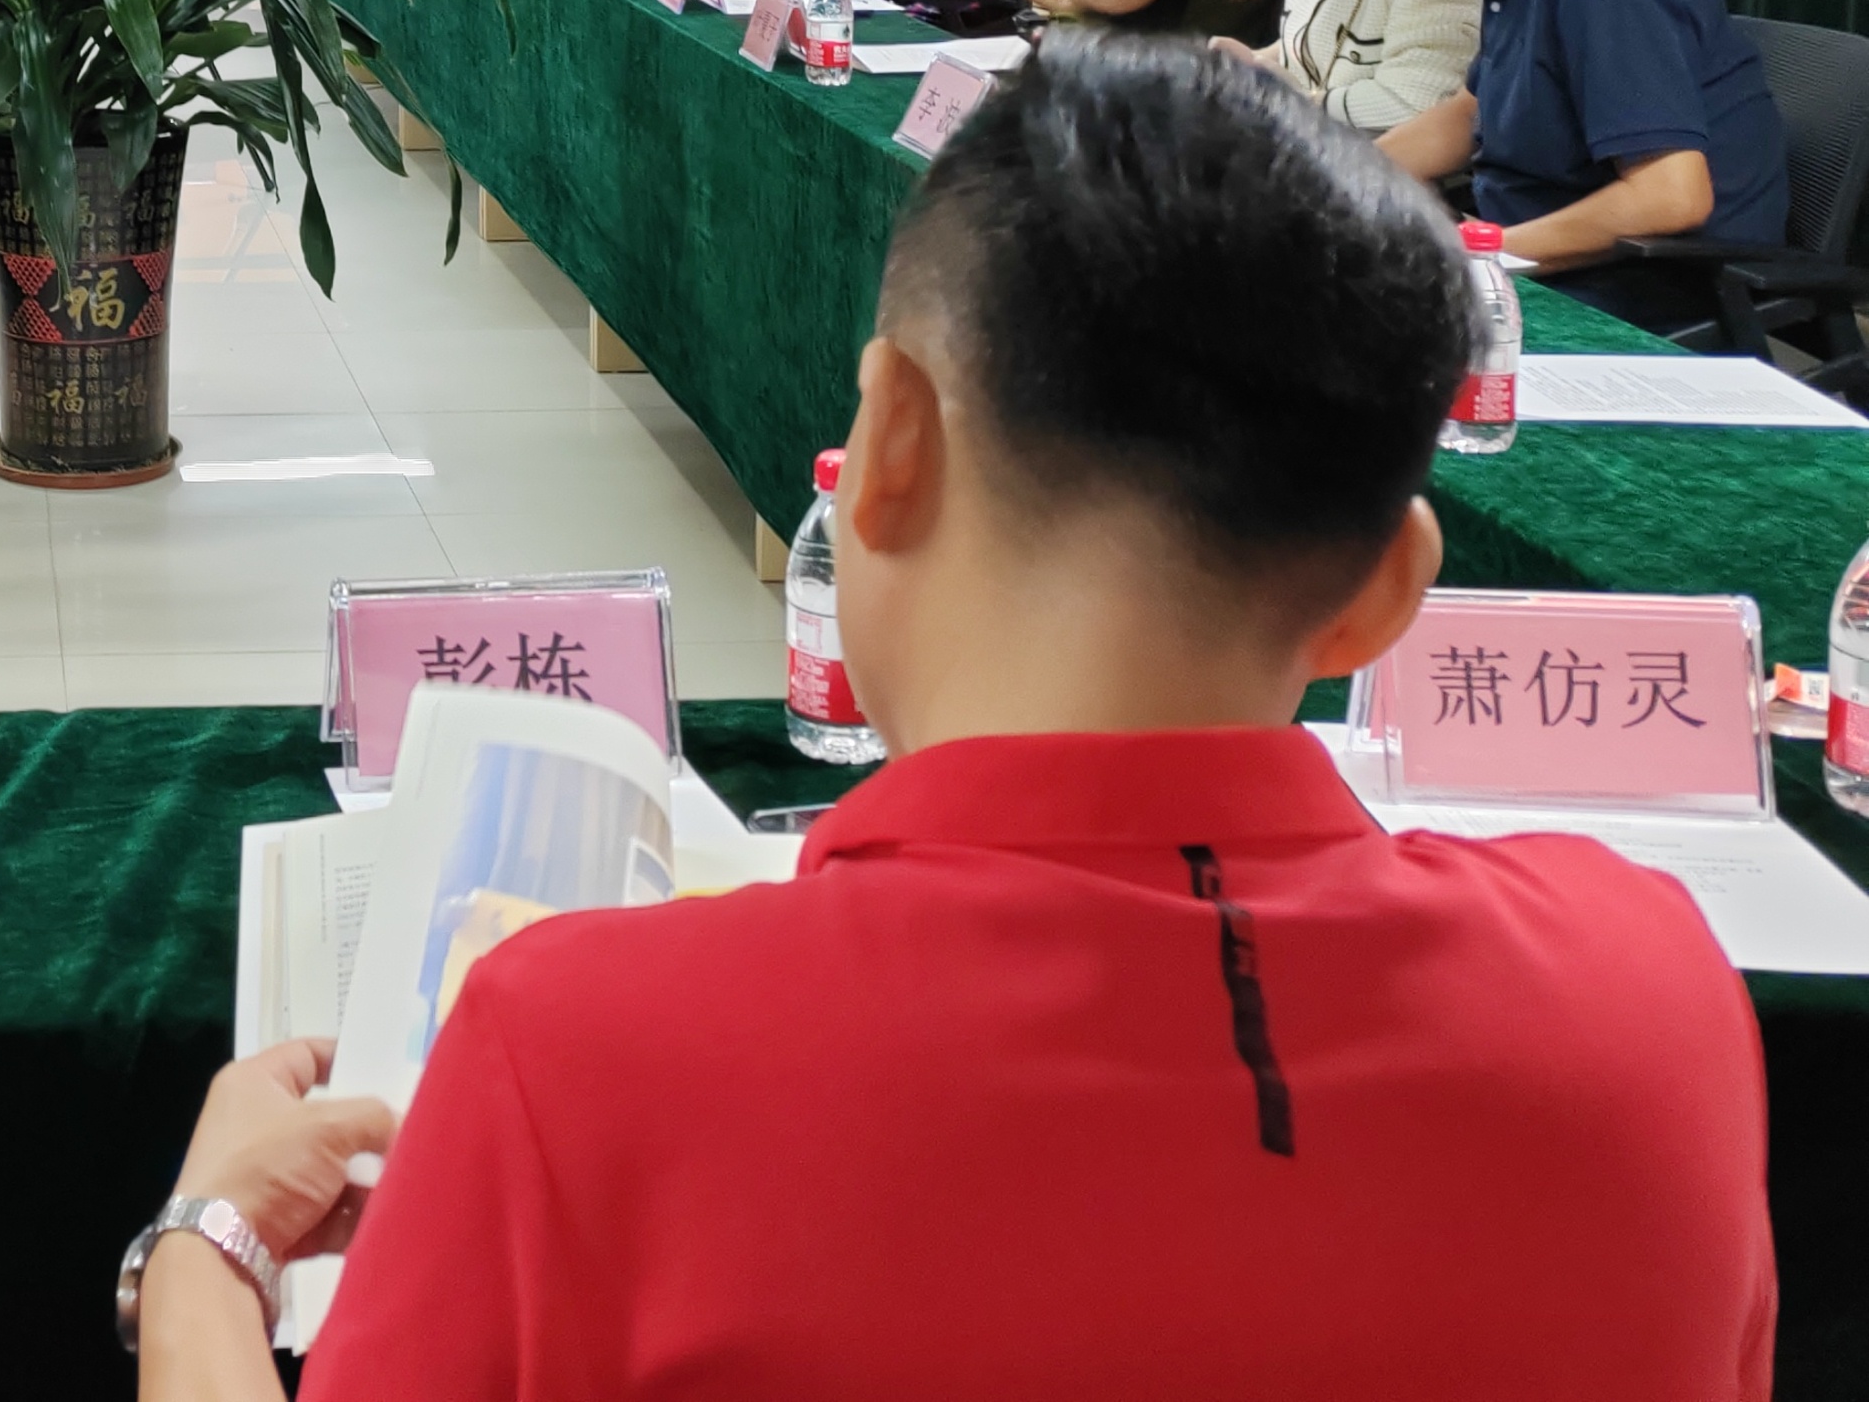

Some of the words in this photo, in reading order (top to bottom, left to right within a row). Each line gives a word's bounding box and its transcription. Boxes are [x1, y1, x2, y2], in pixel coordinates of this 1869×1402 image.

[62, 267, 125, 333] 福
[1429, 644, 1709, 730] 萧仿灵
